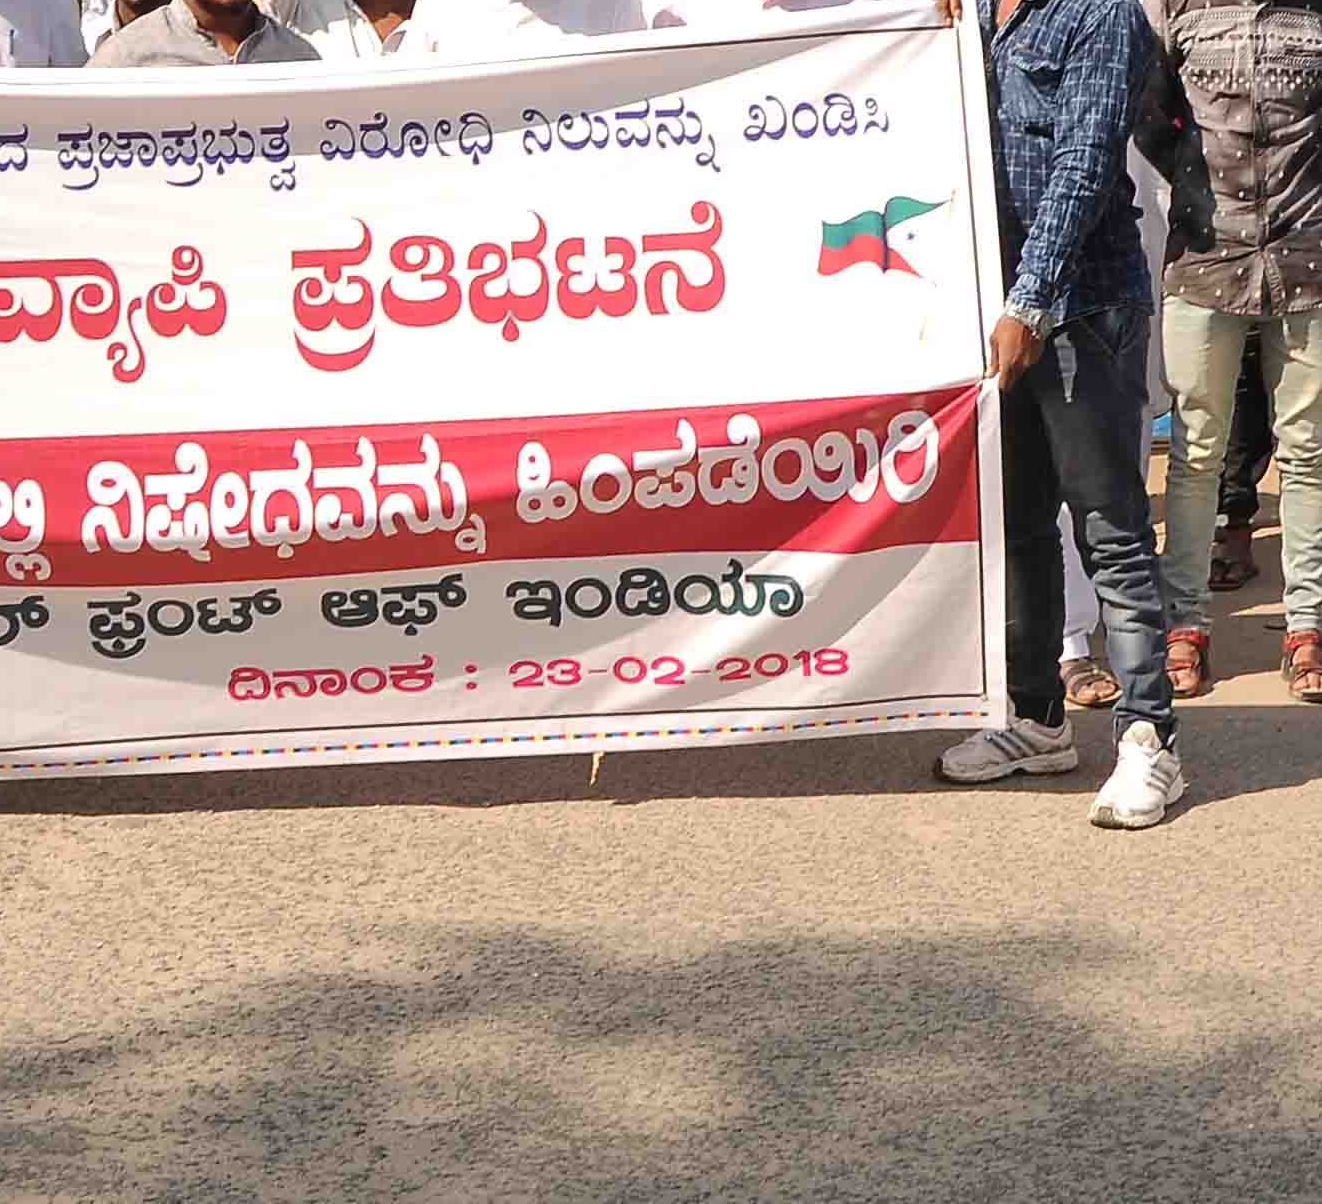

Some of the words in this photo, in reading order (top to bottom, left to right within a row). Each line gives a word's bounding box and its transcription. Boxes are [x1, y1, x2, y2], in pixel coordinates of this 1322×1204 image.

[57, 117, 297, 191] ಪ್ರಜಾಪ್ರಭುತ್ವ
[320, 111, 494, 165] ವಿರೋಧಿ
[522, 96, 721, 173] ನಿಲುವನ್ನು
[743, 92, 890, 142] ಖಂಡಿಸಿ
[290, 200, 726, 373] ಪ್ರತಿಭಟನೆ
[81, 432, 487, 562] ನಿಷೇಧವನ್ನು
[516, 408, 940, 524] ಹಿಂಪಡೆಯಿರಿ
[86, 590, 282, 660] ಫ್ರಂಟ್
[320, 572, 467, 637] ಆಫ್
[505, 557, 805, 627] ಇಂಡಿಯಾ
[227, 653, 435, 703] ದಿನಾಂಕ
[508, 647, 850, 689] 23-02-2018
